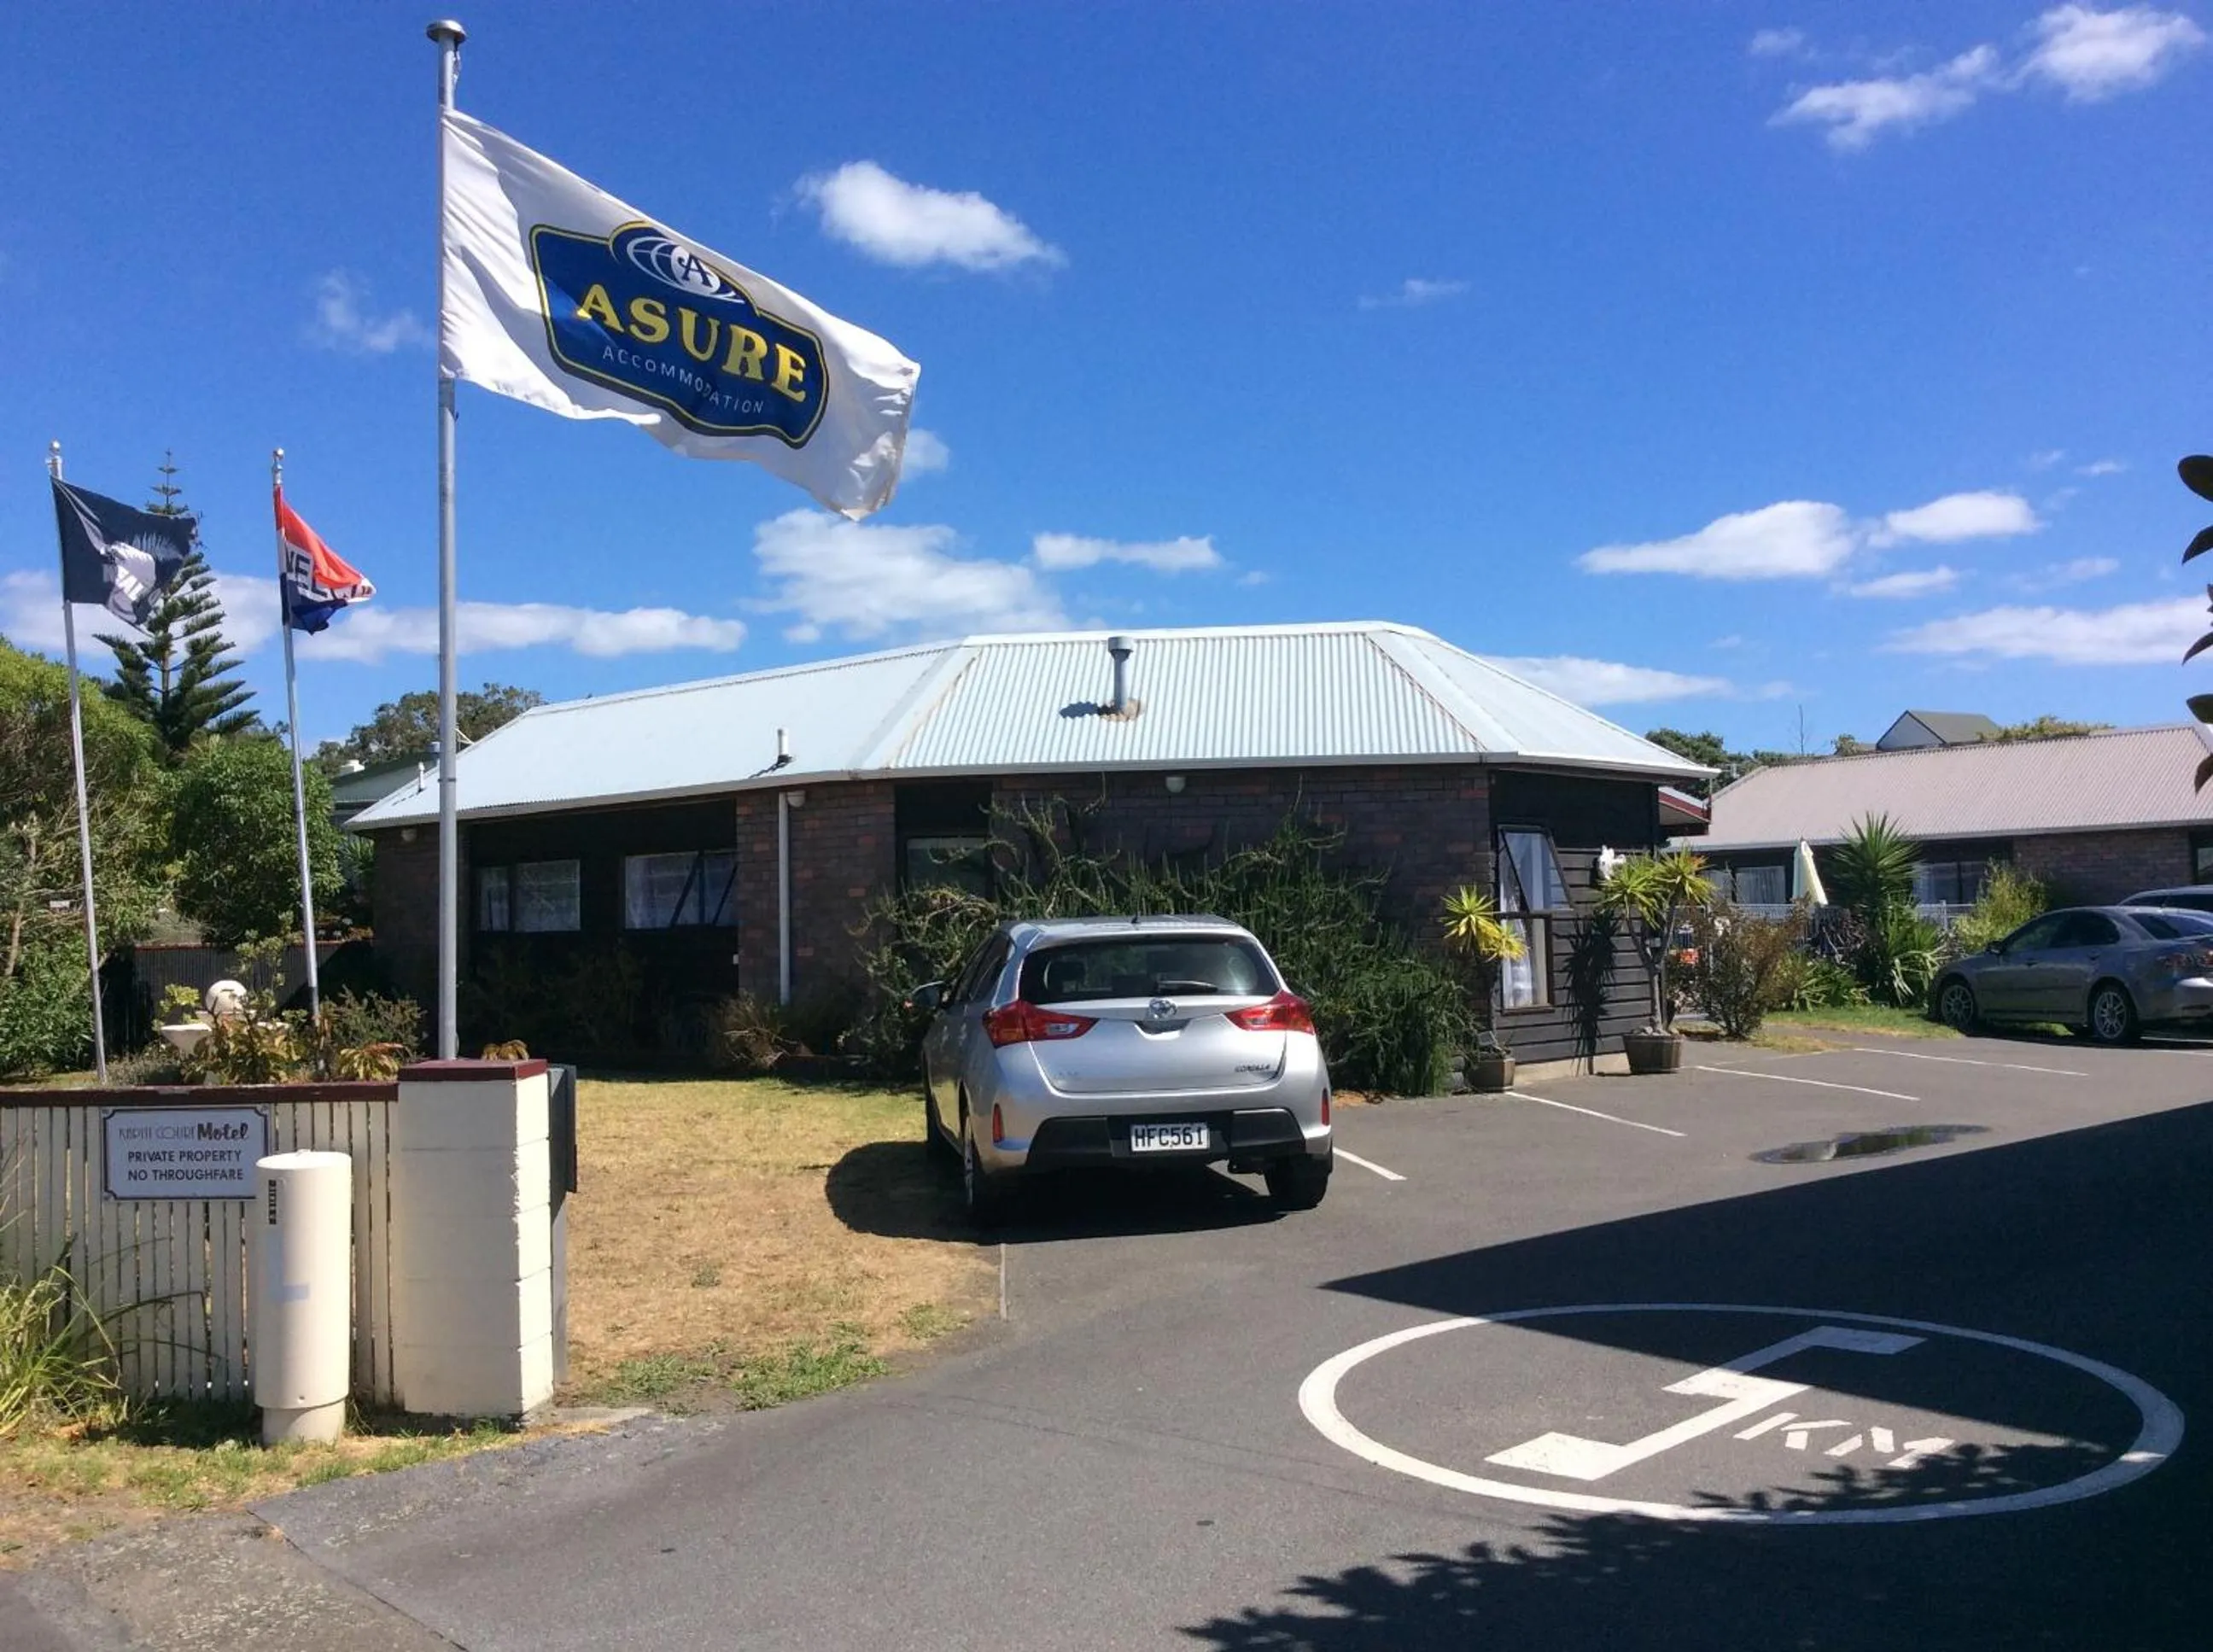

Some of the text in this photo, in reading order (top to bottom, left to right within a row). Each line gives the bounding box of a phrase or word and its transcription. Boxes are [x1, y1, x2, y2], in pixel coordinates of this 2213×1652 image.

[575, 283, 807, 403] ASURE
[602, 345, 764, 414] ACCOMMODATION
[197, 1122, 249, 1141] Motel
[1134, 1126, 1204, 1147] HFC561
[128, 1149, 242, 1162] PRIVATE PROPERTY
[128, 1168, 244, 1181] NO THROUGHFARE
[1732, 1411, 1955, 1469] KM
